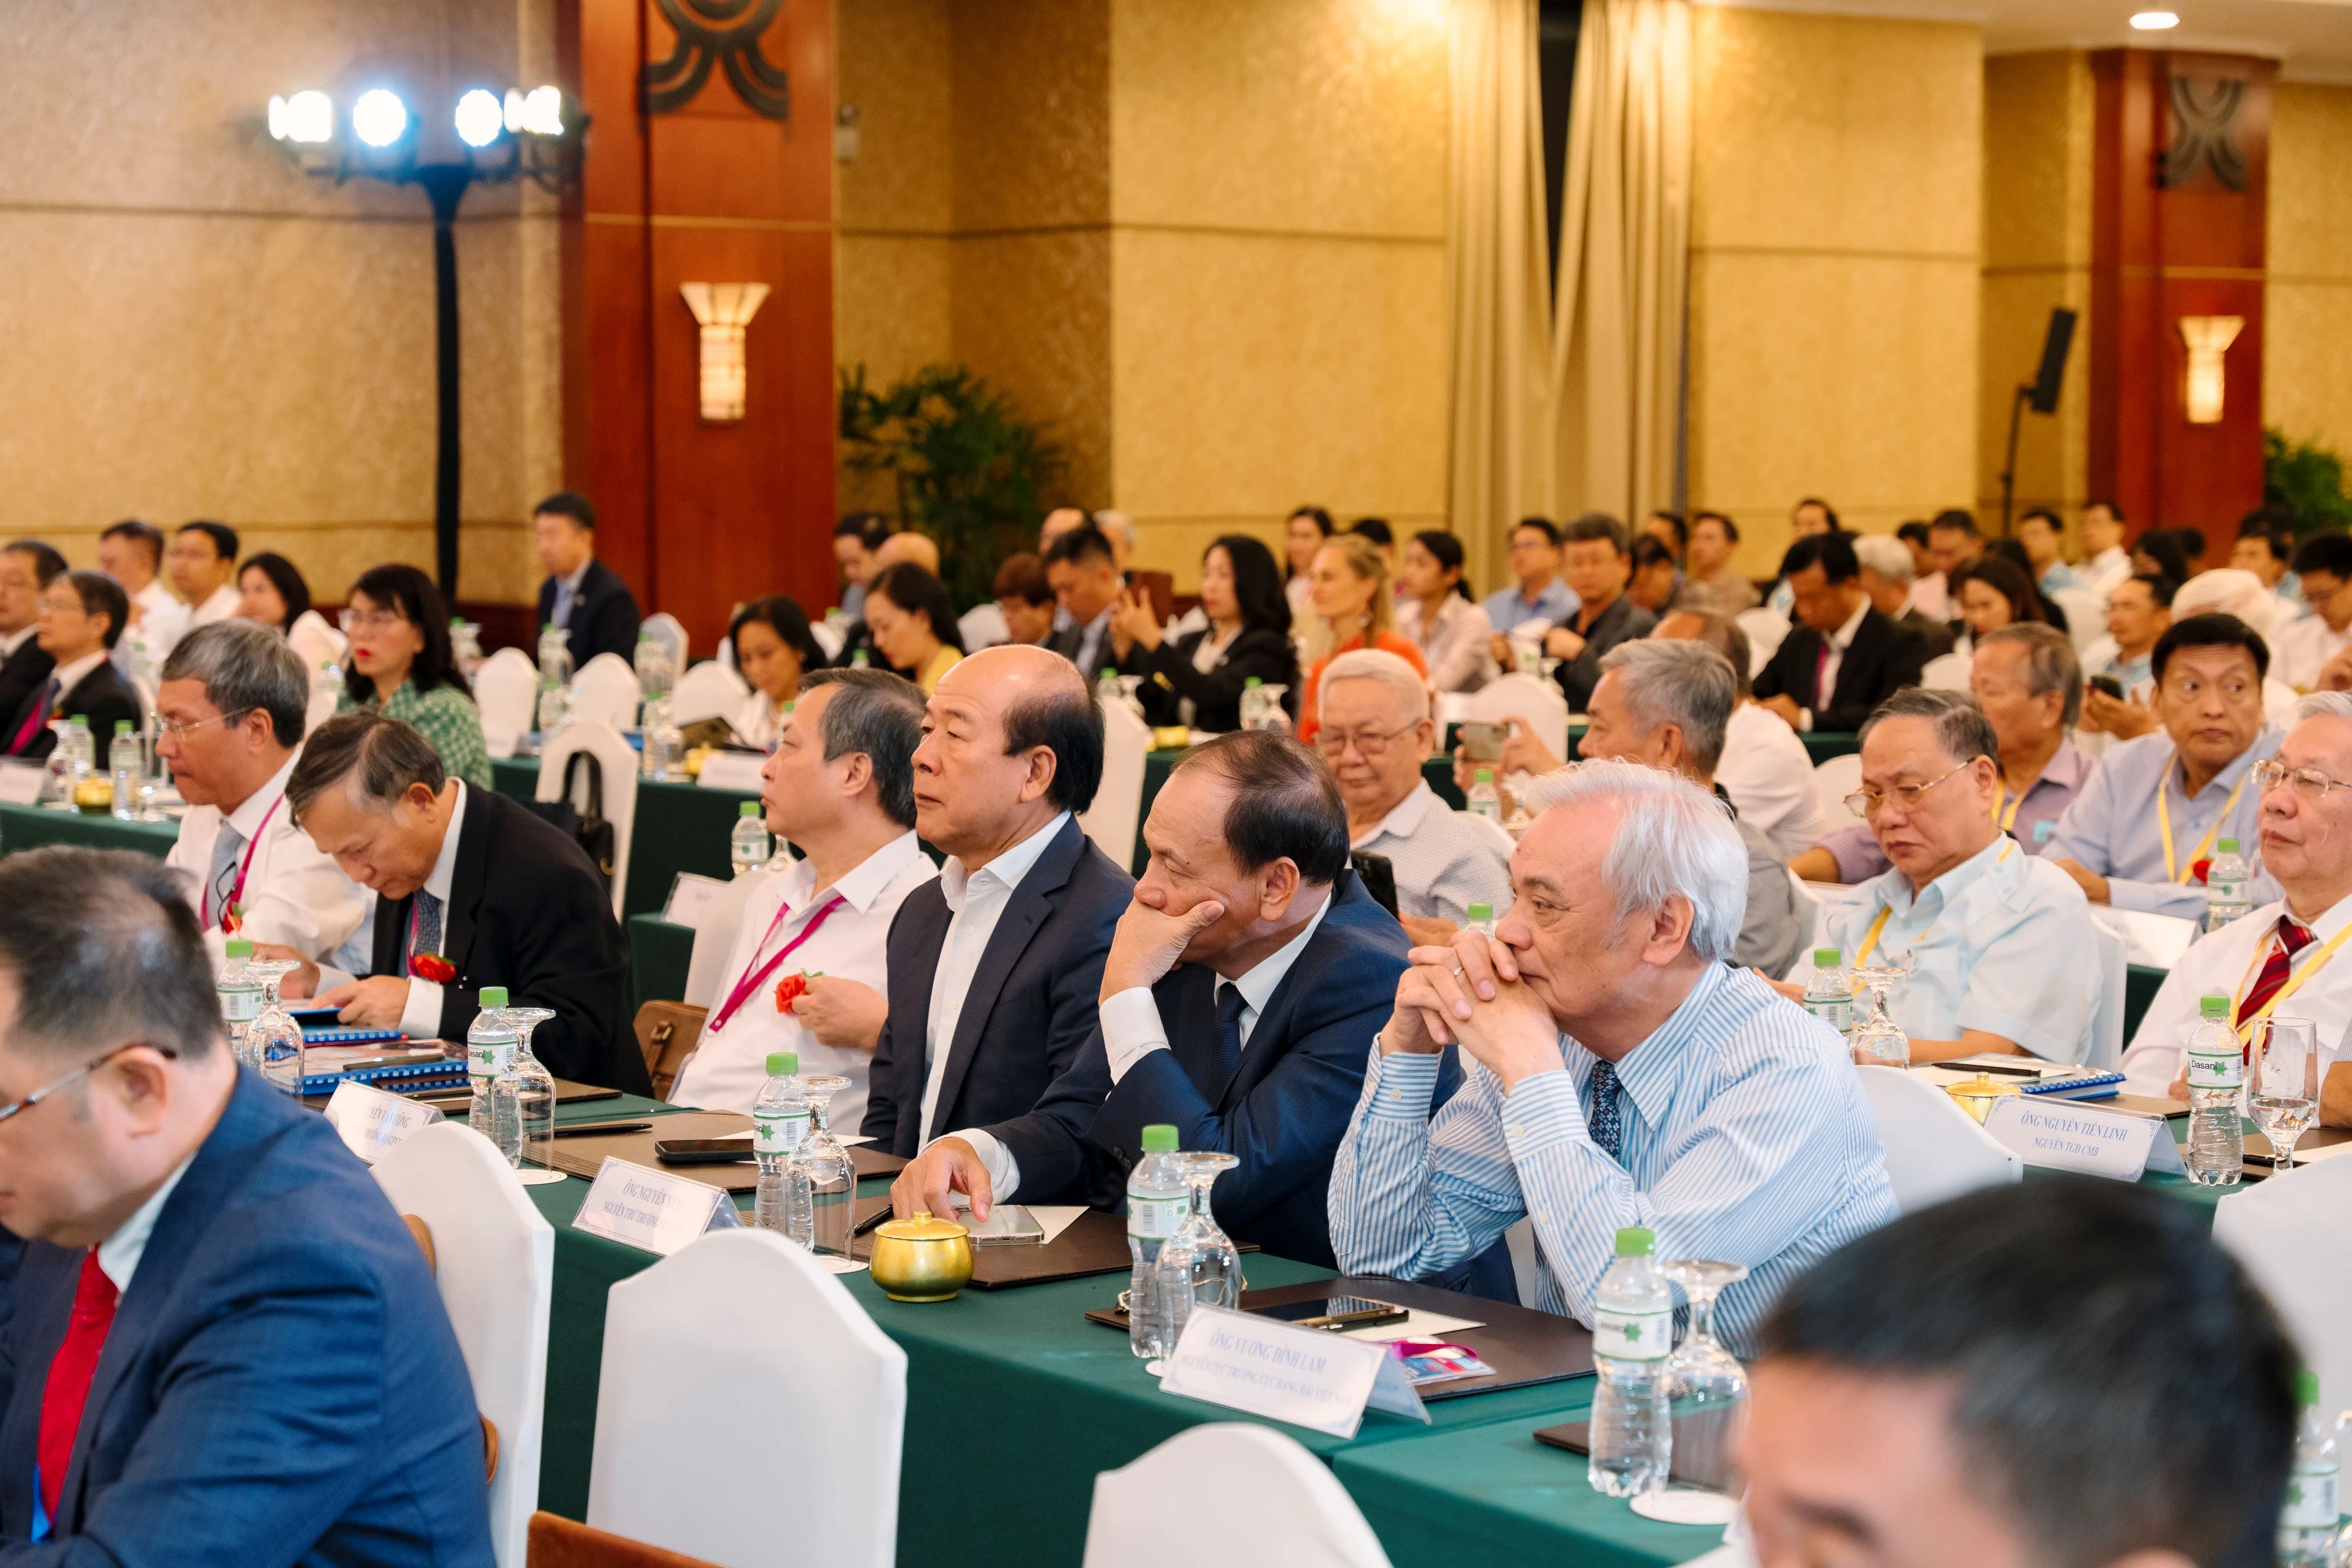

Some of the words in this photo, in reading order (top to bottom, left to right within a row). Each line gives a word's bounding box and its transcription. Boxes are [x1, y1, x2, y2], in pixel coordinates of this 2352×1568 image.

[468, 1049, 485, 1058] asani
[2191, 1060, 2217, 1070] Dasani
[2021, 1110, 2042, 1127] ÔNG
[2041, 1116, 2081, 1134] NGUYỄN
[2081, 1121, 2104, 1137] TIẾN
[2103, 1126, 2129, 1141] LINH
[2082, 1145, 2100, 1157] CMB
[623, 1178, 640, 1197] ÔNG
[1210, 1328, 1235, 1351] ÔNG
[1235, 1336, 1273, 1360] VƯƠNG
